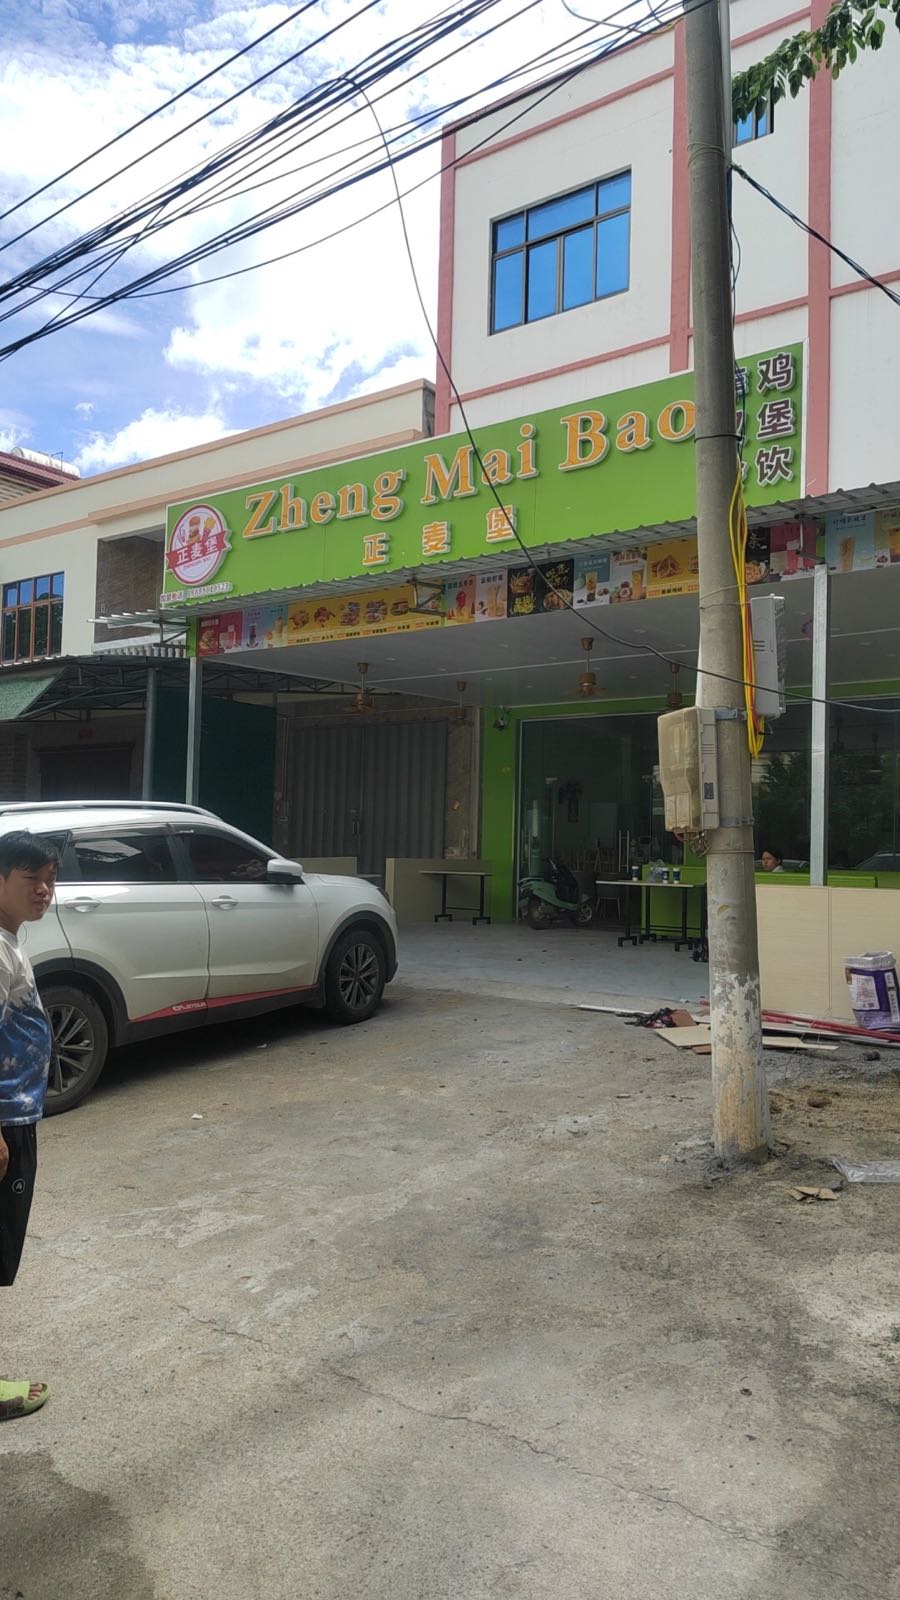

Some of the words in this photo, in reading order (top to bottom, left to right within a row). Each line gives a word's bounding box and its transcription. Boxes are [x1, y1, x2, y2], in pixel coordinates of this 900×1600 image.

[243, 469, 407, 540] Zheng
[421, 423, 539, 506] Mai
[559, 400, 696, 472] Bao
[177, 537, 218, 564] 正麦堡
[362, 506, 517, 565] 正麦堡
